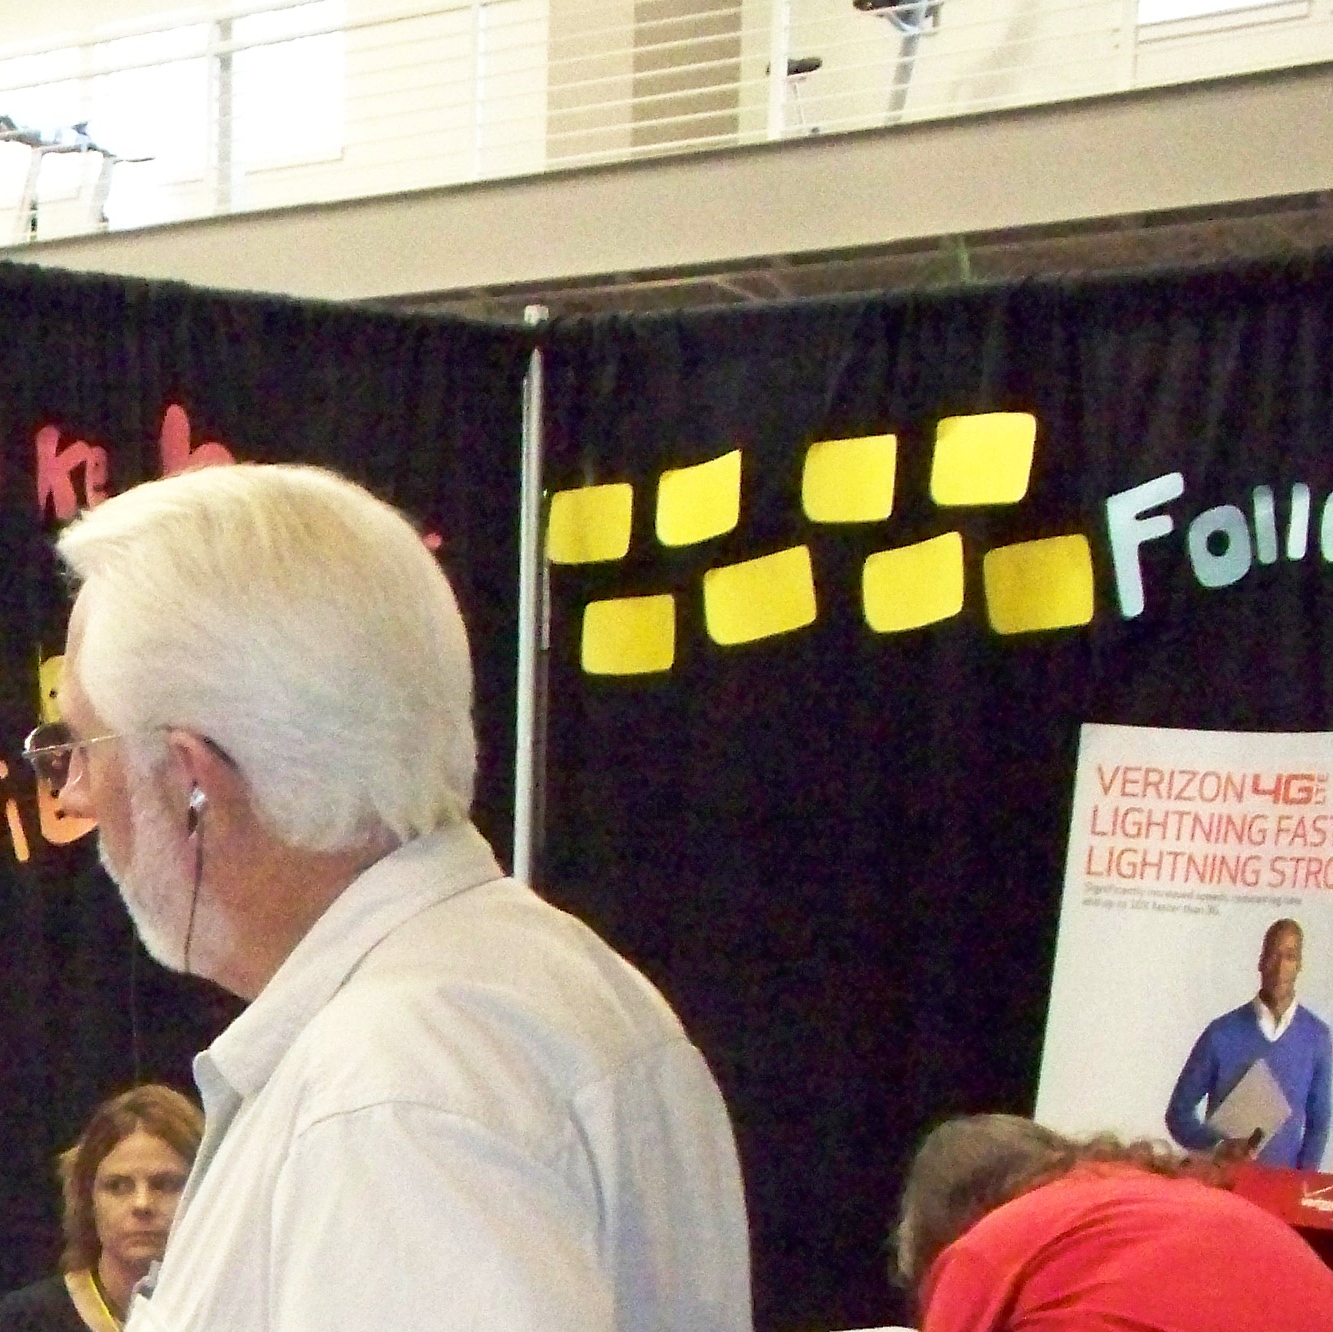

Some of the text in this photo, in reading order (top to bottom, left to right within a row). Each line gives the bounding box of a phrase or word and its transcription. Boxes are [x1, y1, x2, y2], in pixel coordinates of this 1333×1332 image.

[1107, 472, 1333, 621] Foll
[1097, 764, 1247, 804] VERIZON
[1252, 773, 1316, 806] 4G
[1090, 804, 1333, 848] LIGHTNING FAS
[1086, 845, 1263, 888] LIGHTNING
